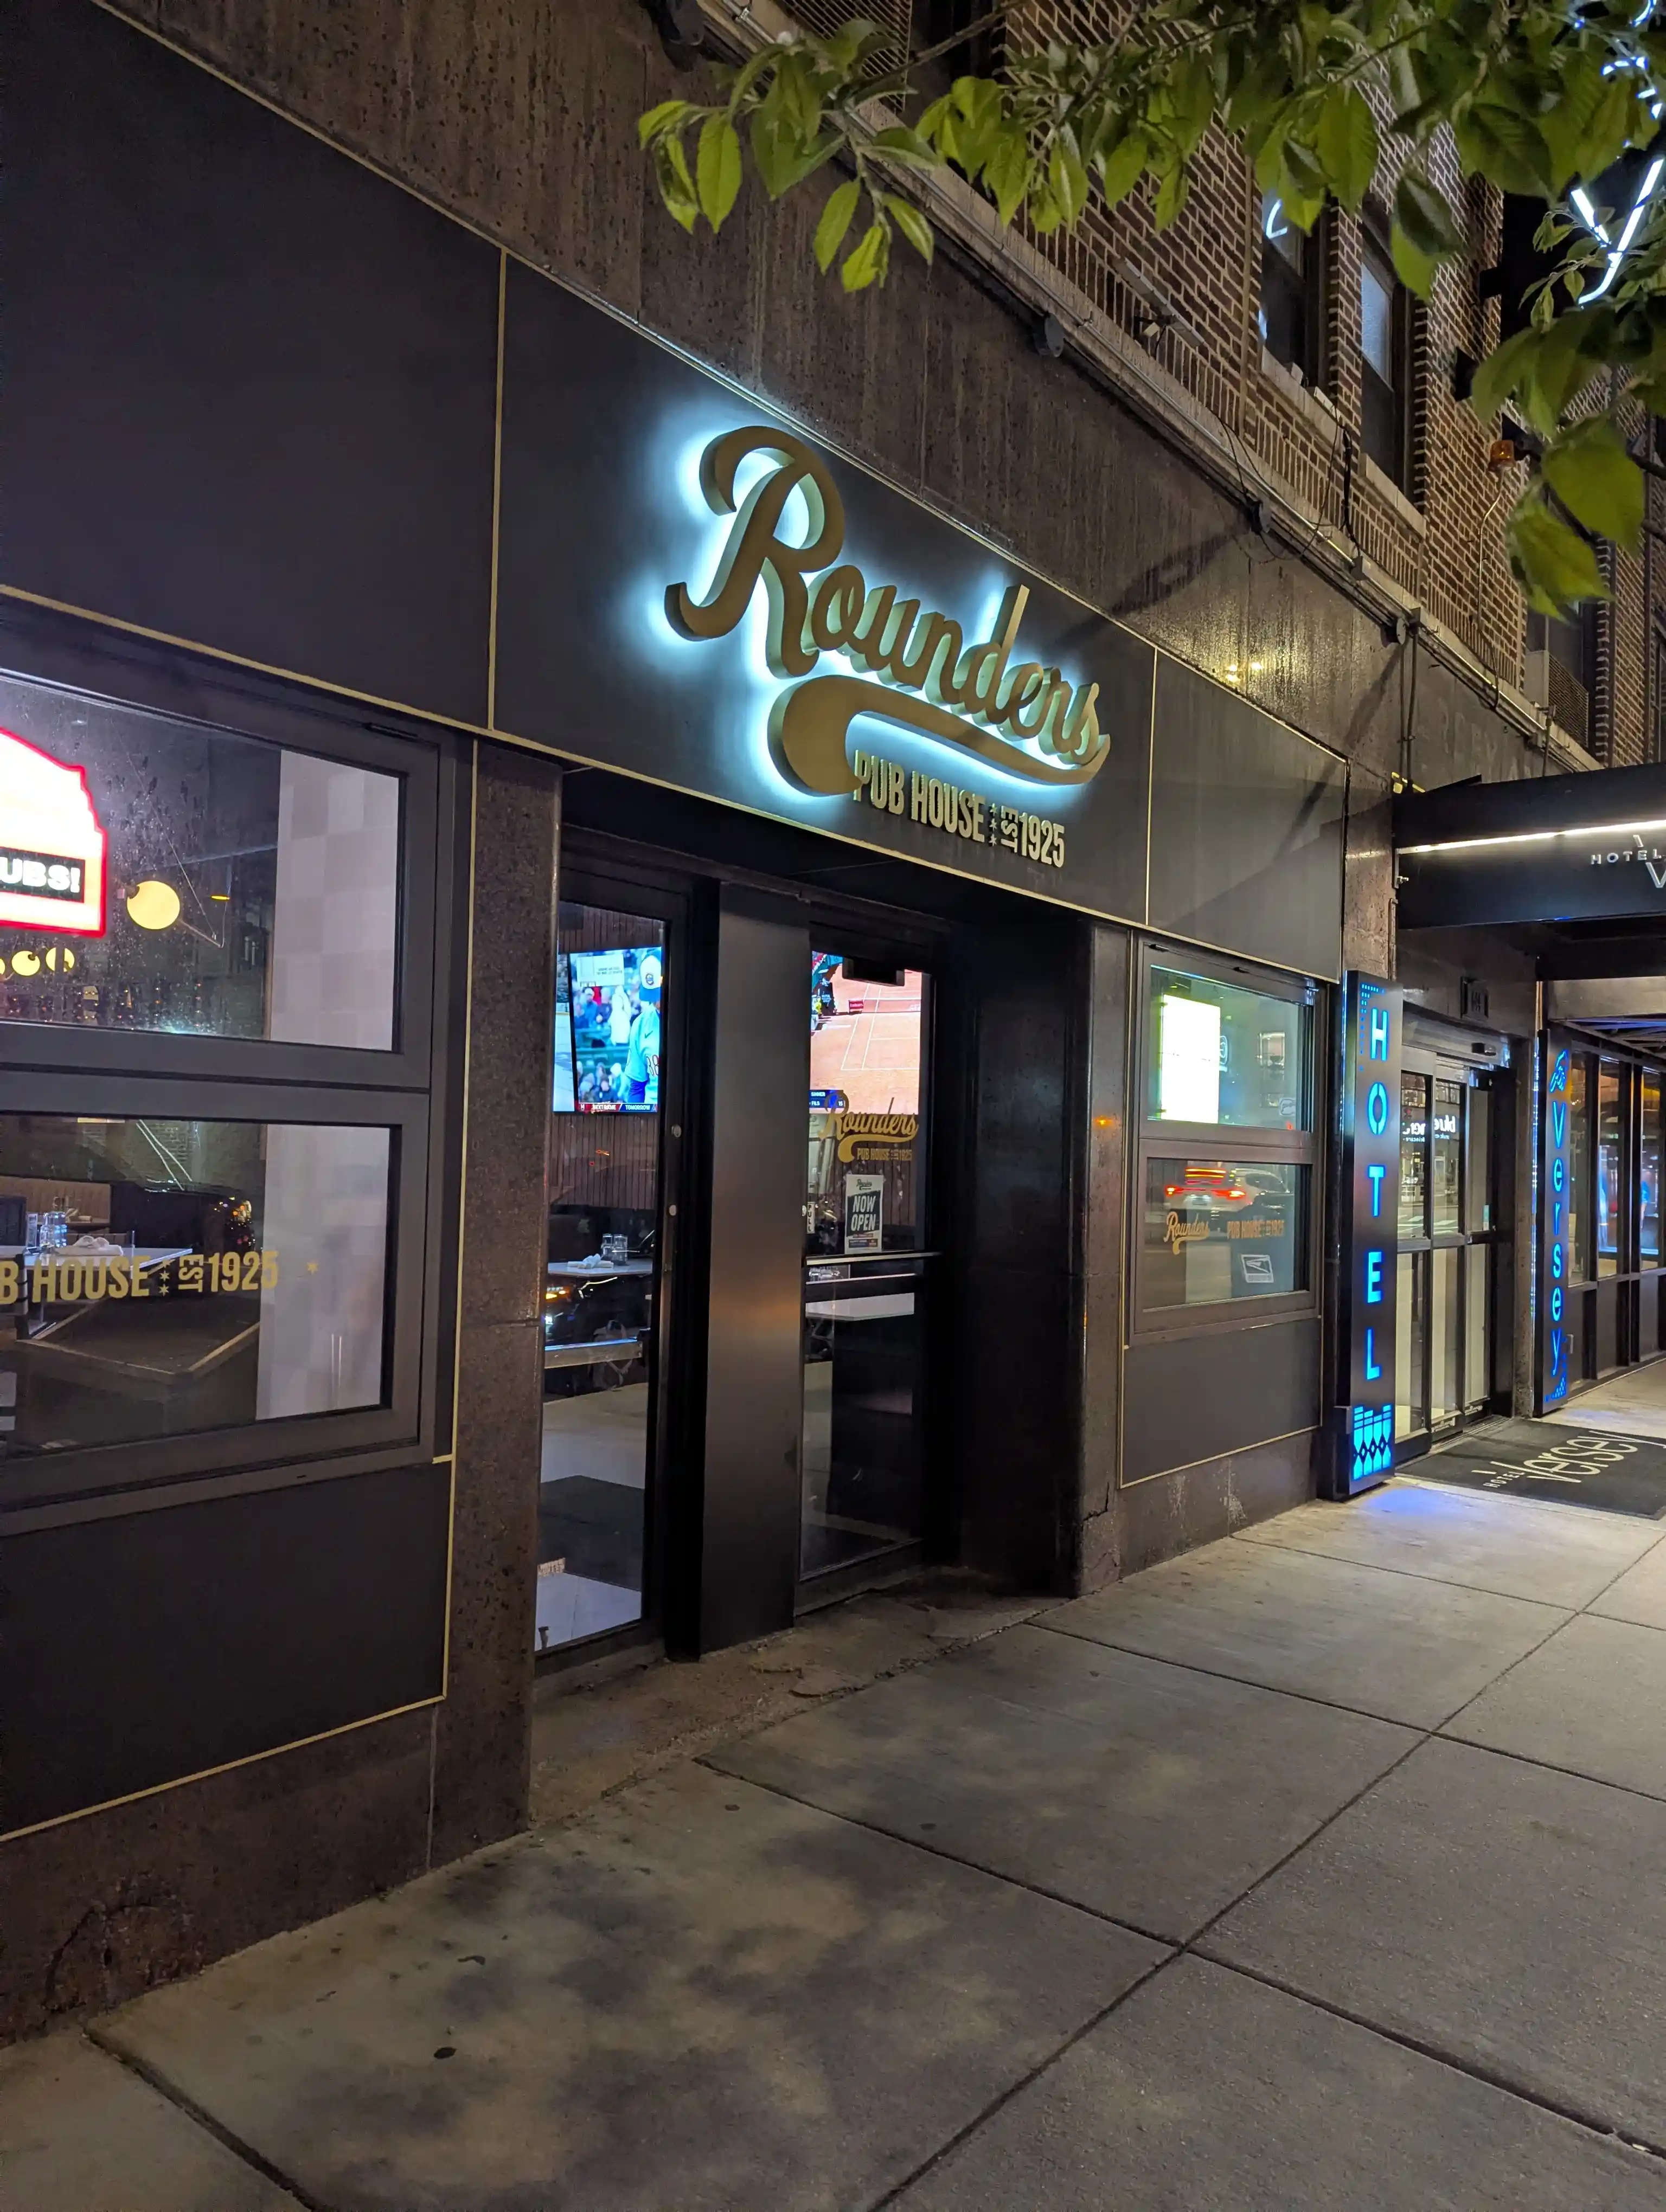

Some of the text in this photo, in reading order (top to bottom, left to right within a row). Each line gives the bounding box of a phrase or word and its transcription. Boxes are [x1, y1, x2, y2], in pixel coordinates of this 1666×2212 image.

[664, 426, 1110, 770] Rounders
[853, 749, 1065, 868] PUB HOUSE EST 1925
[1591, 848, 1662, 865] HOTEL
[818, 1090, 919, 1142] Rounders
[853, 1195, 876, 1212] NOW
[1367, 1007, 1388, 1380] HOTEL
[851, 1214, 876, 1231] OPEN
[1163, 1211, 1210, 1243] Rounders
[1552, 1101, 1566, 1376] Versey
[32, 1255, 150, 1303] HOUSE
[178, 1254, 204, 1293] EST
[210, 1251, 279, 1292] 1925
[1483, 1471, 1525, 1488] HOTEL
[1490, 1430, 1666, 1483] Versey
